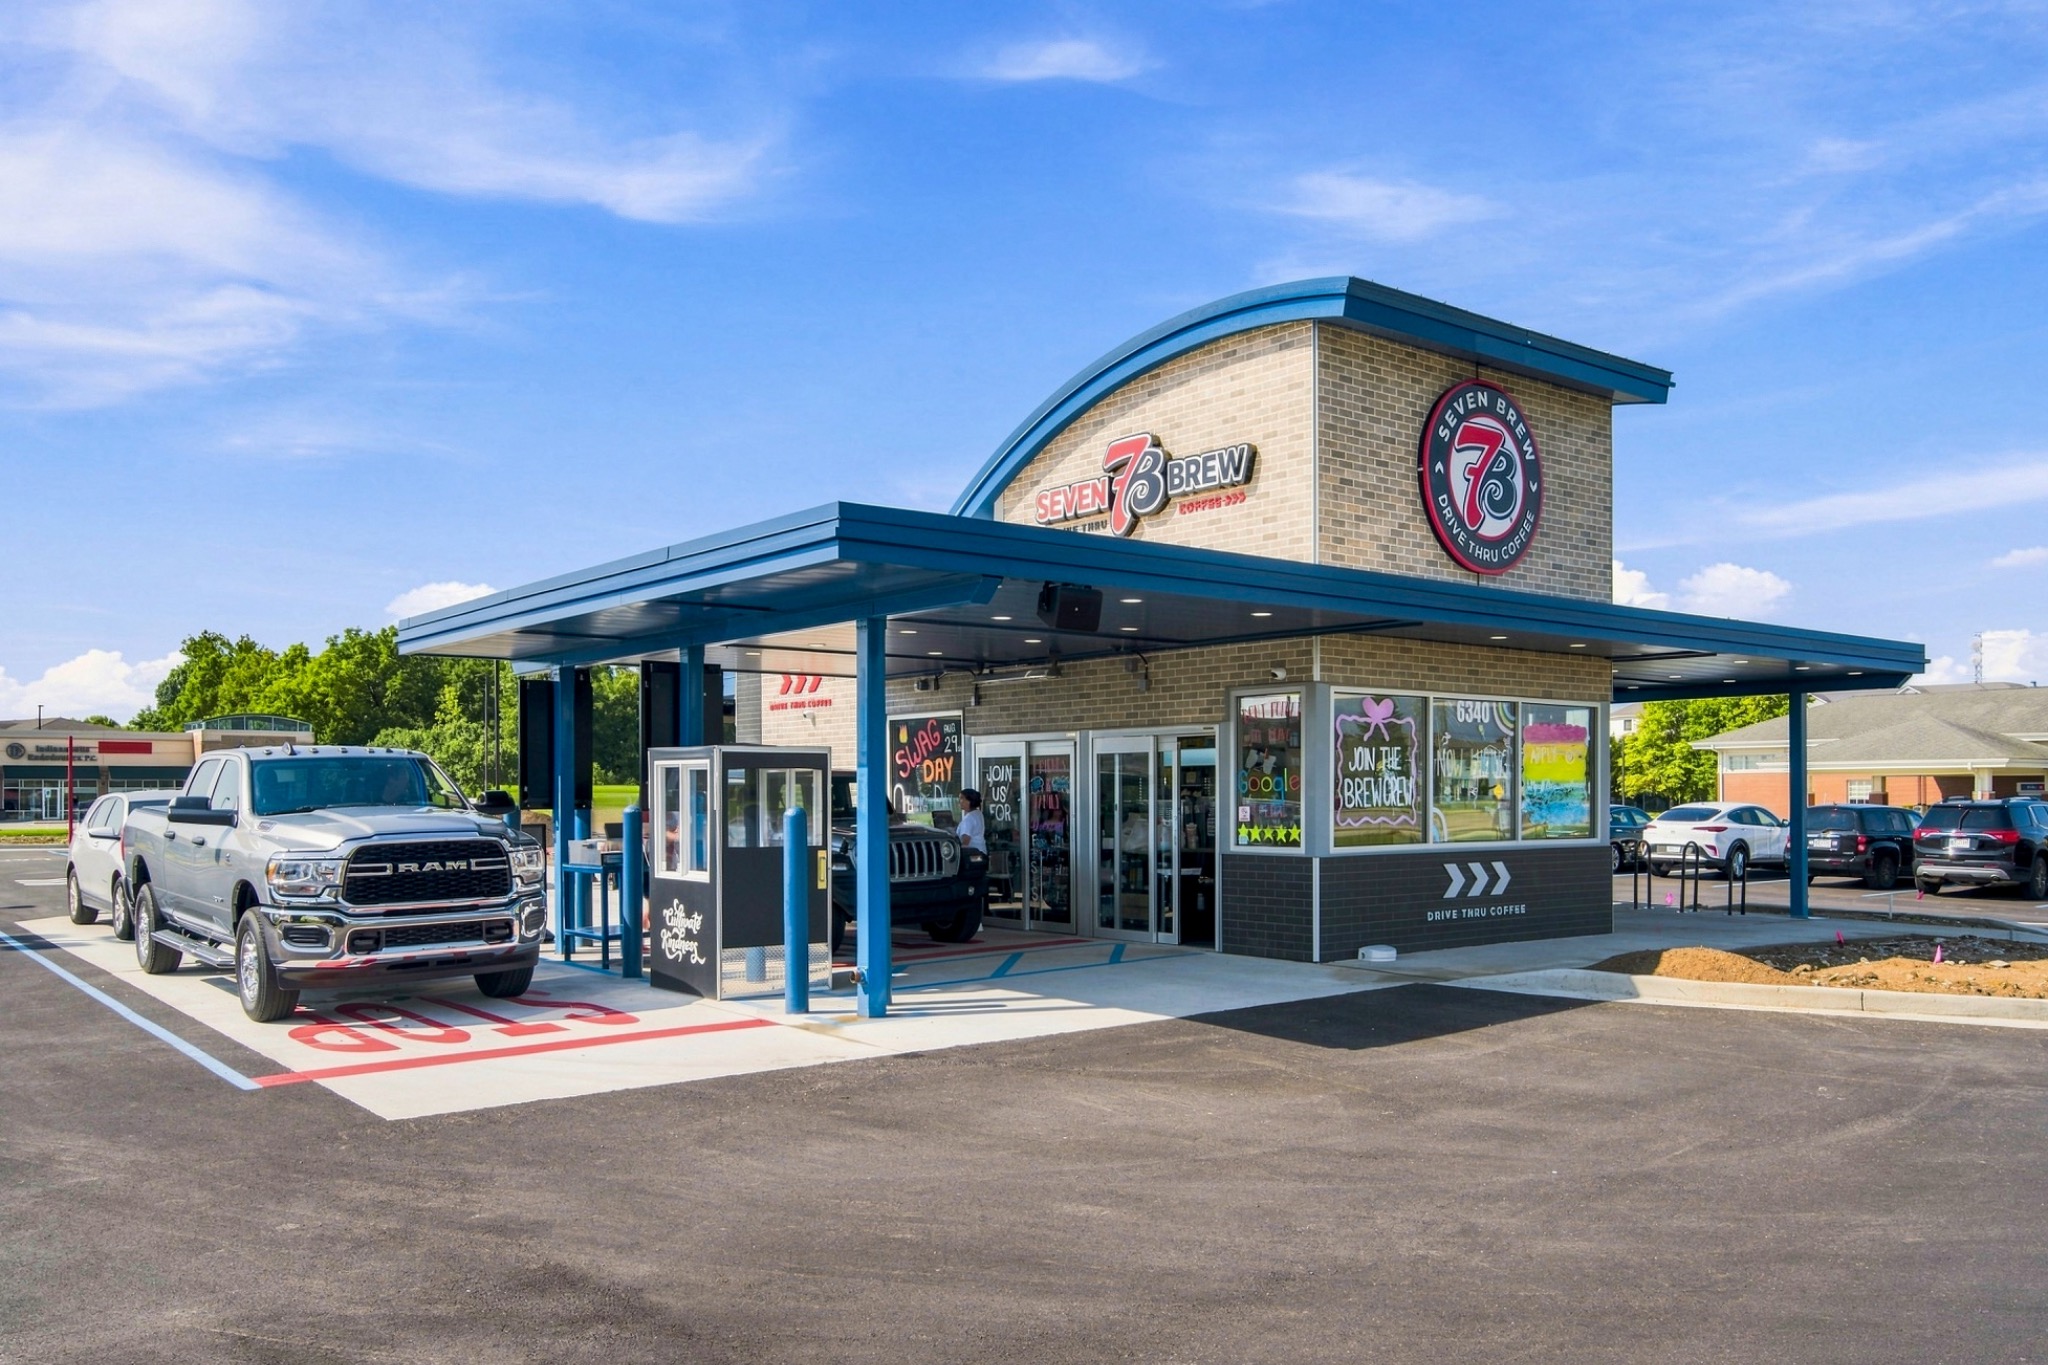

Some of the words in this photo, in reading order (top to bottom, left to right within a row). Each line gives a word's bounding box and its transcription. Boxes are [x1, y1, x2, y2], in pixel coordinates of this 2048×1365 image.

[1438, 391, 1488, 442] SEVEN
[1496, 398, 1536, 460] BREW
[1036, 477, 1109, 522] SEVEN
[1168, 443, 1249, 496] BREW
[1082, 520, 1108, 532] THRU
[1179, 496, 1222, 515] COFFEE
[1438, 494, 1467, 547] DRIVE
[1468, 540, 1499, 563] THRU
[1501, 509, 1535, 560] COFFEE
[1457, 700, 1490, 723] 6340
[895, 719, 941, 778] SWAG
[1348, 746, 1376, 772] JOIN
[1380, 746, 1402, 771] THE
[923, 756, 954, 783] DAY
[986, 764, 1013, 788] JOIN
[992, 786, 1007, 803] US
[1238, 768, 1300, 806] Google
[989, 804, 1012, 822] FOR
[398, 860, 468, 873] RAM
[1427, 909, 1459, 921] DRIVE
[1461, 906, 1487, 919] THRU
[1489, 904, 1526, 916] COFFEE
